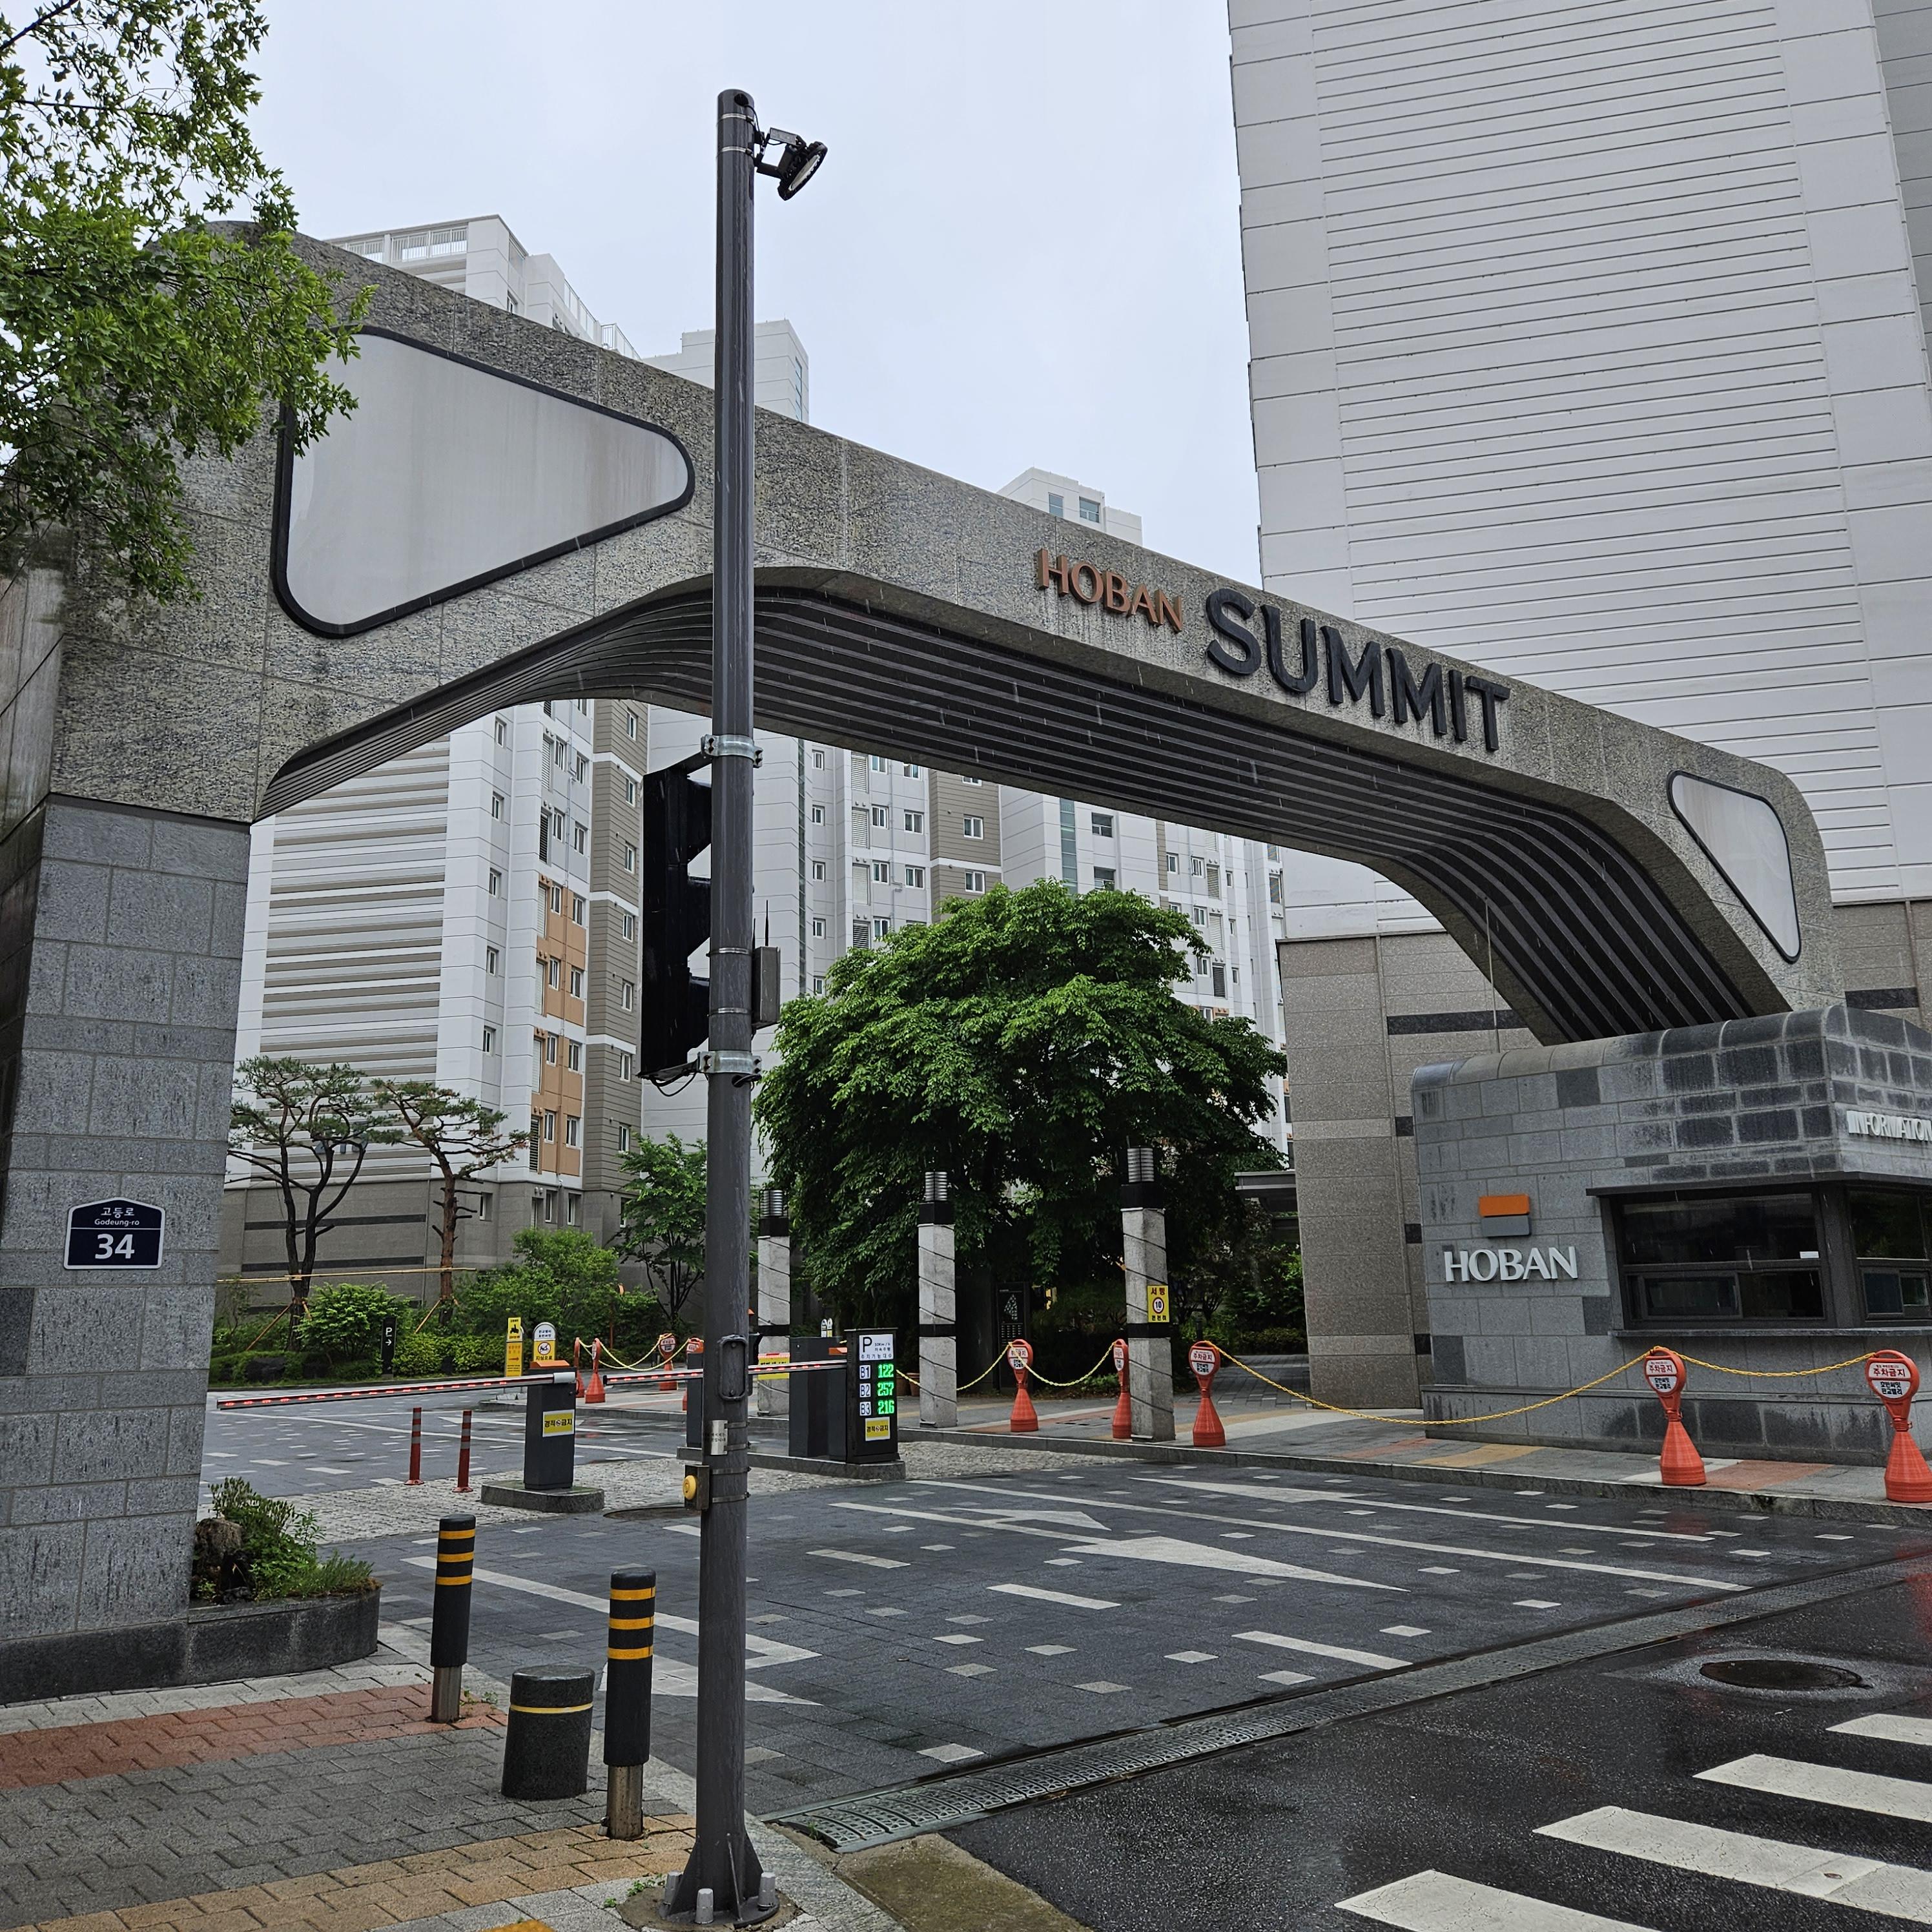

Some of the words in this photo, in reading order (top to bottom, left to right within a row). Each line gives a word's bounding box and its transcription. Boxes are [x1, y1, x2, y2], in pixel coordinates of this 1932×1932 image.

[1036, 548, 1183, 633] HOBAN
[1206, 587, 1511, 752] SUMMIT
[1847, 1110, 1932, 1142] INFORMATION
[101, 1207, 135, 1218] 고등로
[94, 1218, 140, 1227] Godeung-ro
[95, 1233, 135, 1259] 34
[1444, 1246, 1578, 1282] HOBAN
[1151, 1287, 1166, 1295] 서행
[863, 1336, 872, 1353] P
[1193, 1352, 1213, 1361] 주차금지
[861, 1366, 869, 1379] B1
[878, 1363, 894, 1379] 122
[1649, 1364, 1673, 1373] 주차금지
[1873, 1368, 1906, 1377] 주차금지
[861, 1384, 870, 1397] B2
[878, 1382, 894, 1397] 257
[861, 1403, 870, 1415] B3
[878, 1400, 894, 1415] 216
[561, 1418, 572, 1426] 금지
